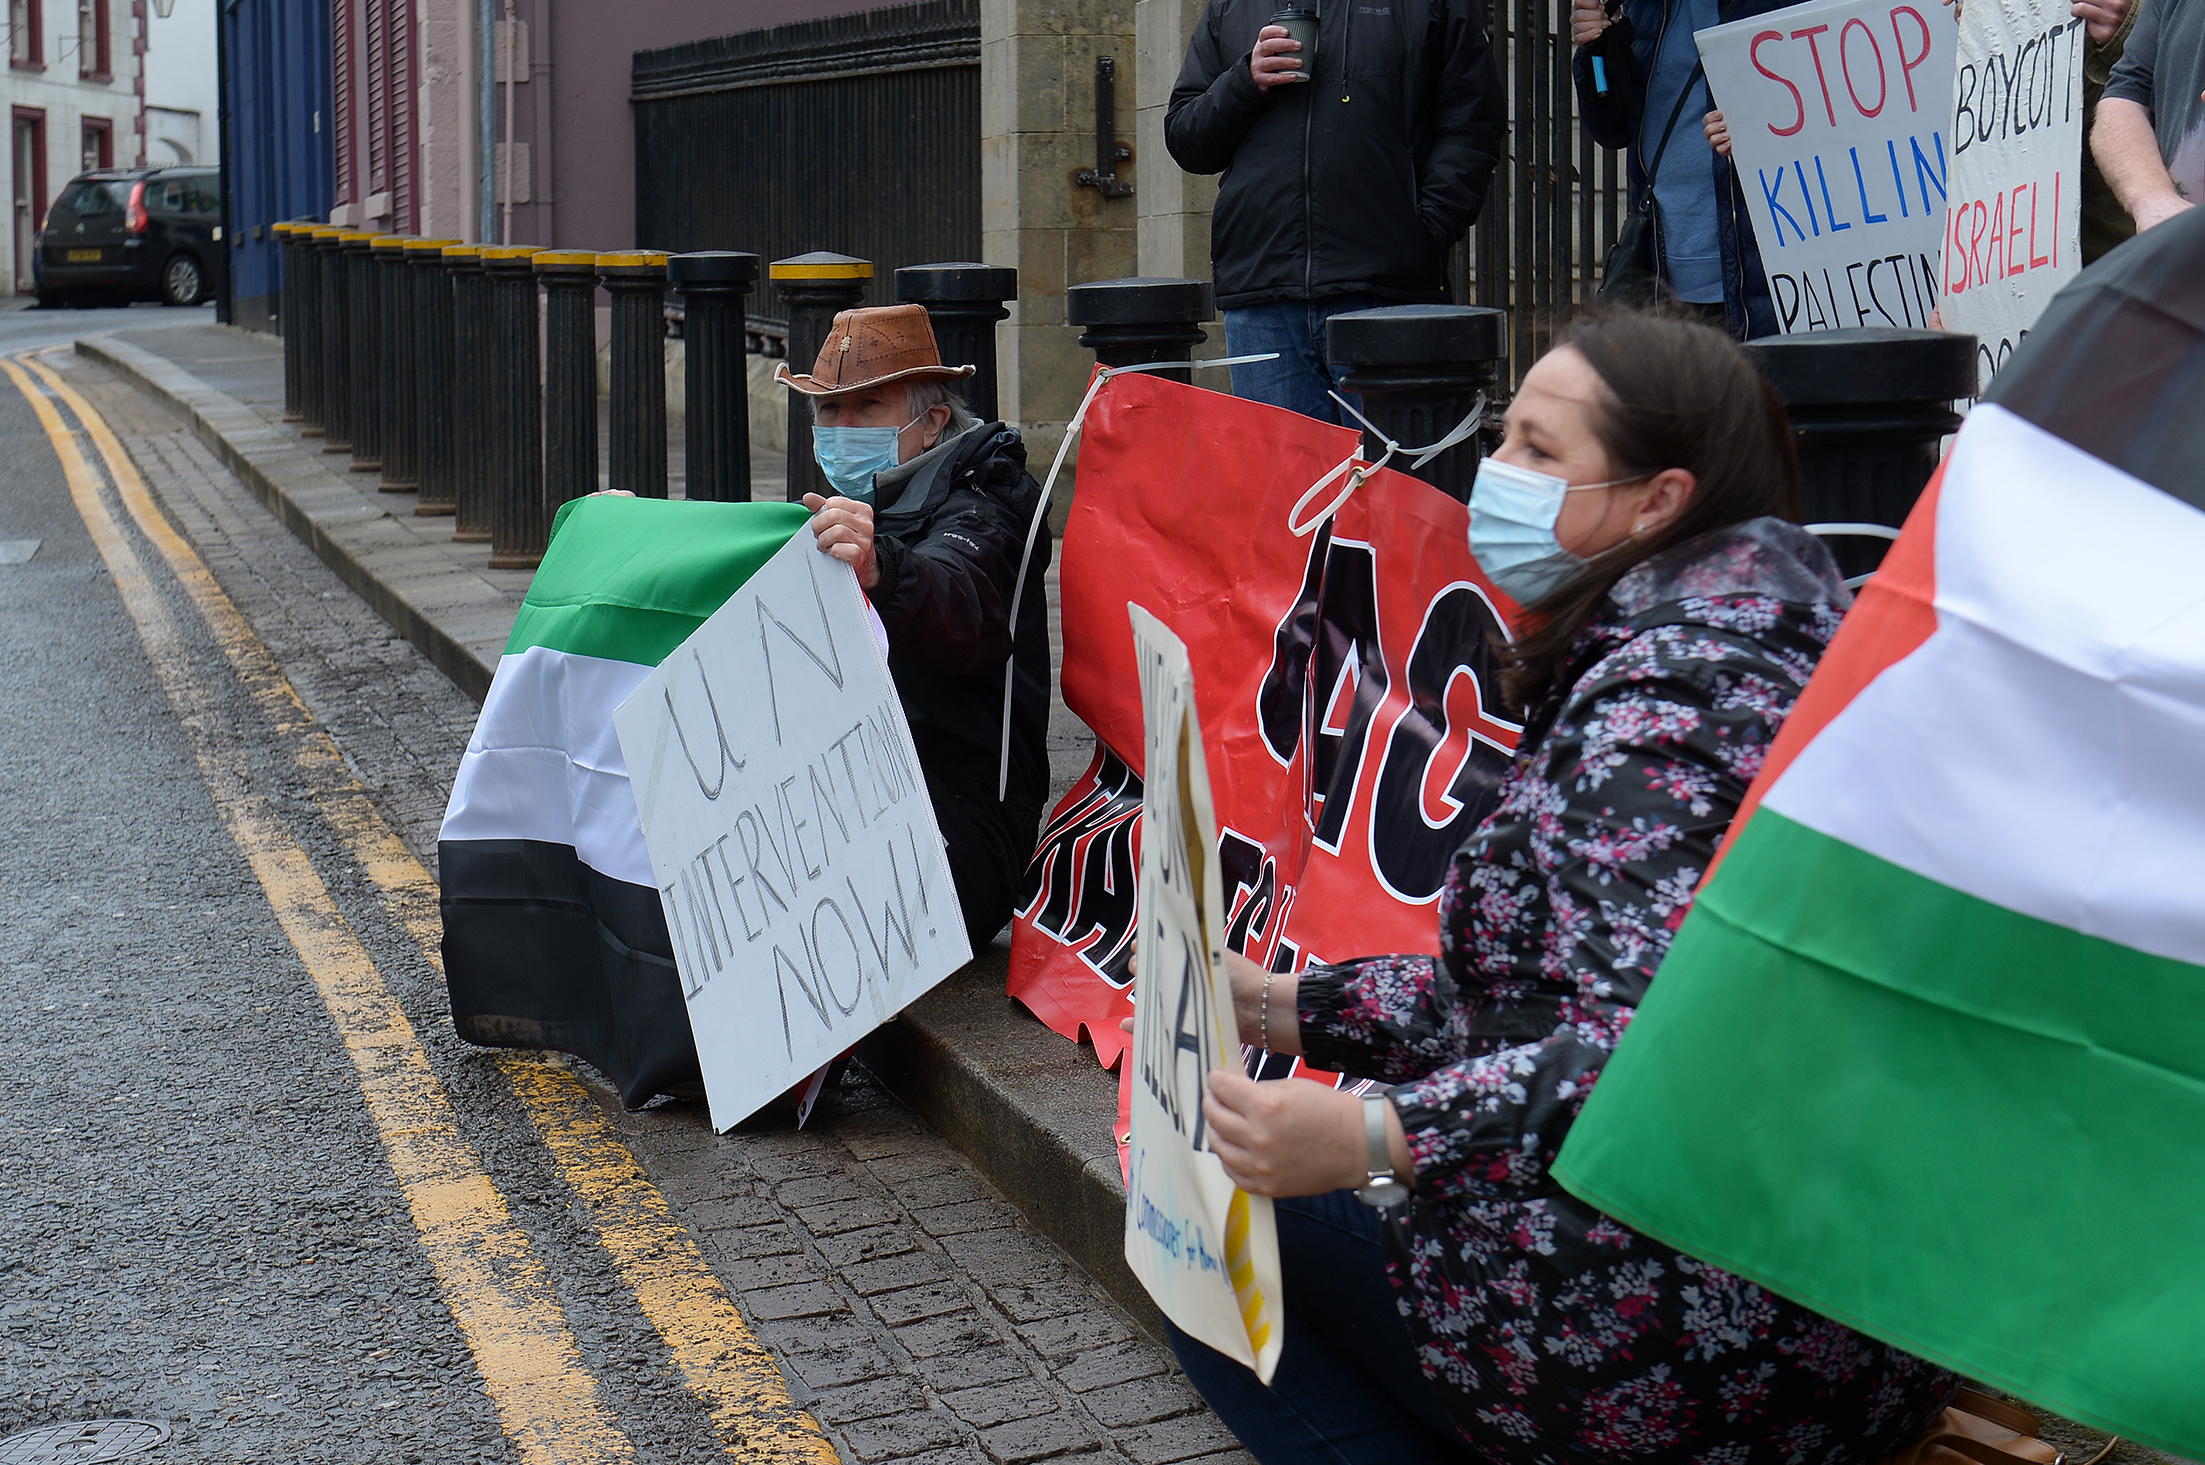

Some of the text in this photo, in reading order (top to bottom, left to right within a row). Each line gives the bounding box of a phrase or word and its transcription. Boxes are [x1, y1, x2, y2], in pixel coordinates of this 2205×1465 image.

[1749, 6, 1932, 137] STOP
[1956, 17, 2083, 155] BOYCOTT
[1758, 132, 1947, 247] KILLIN
[1944, 171, 2060, 297] ISRAELI
[662, 699, 917, 1001] INTERVENTION
[772, 822, 938, 1063] NOW!
